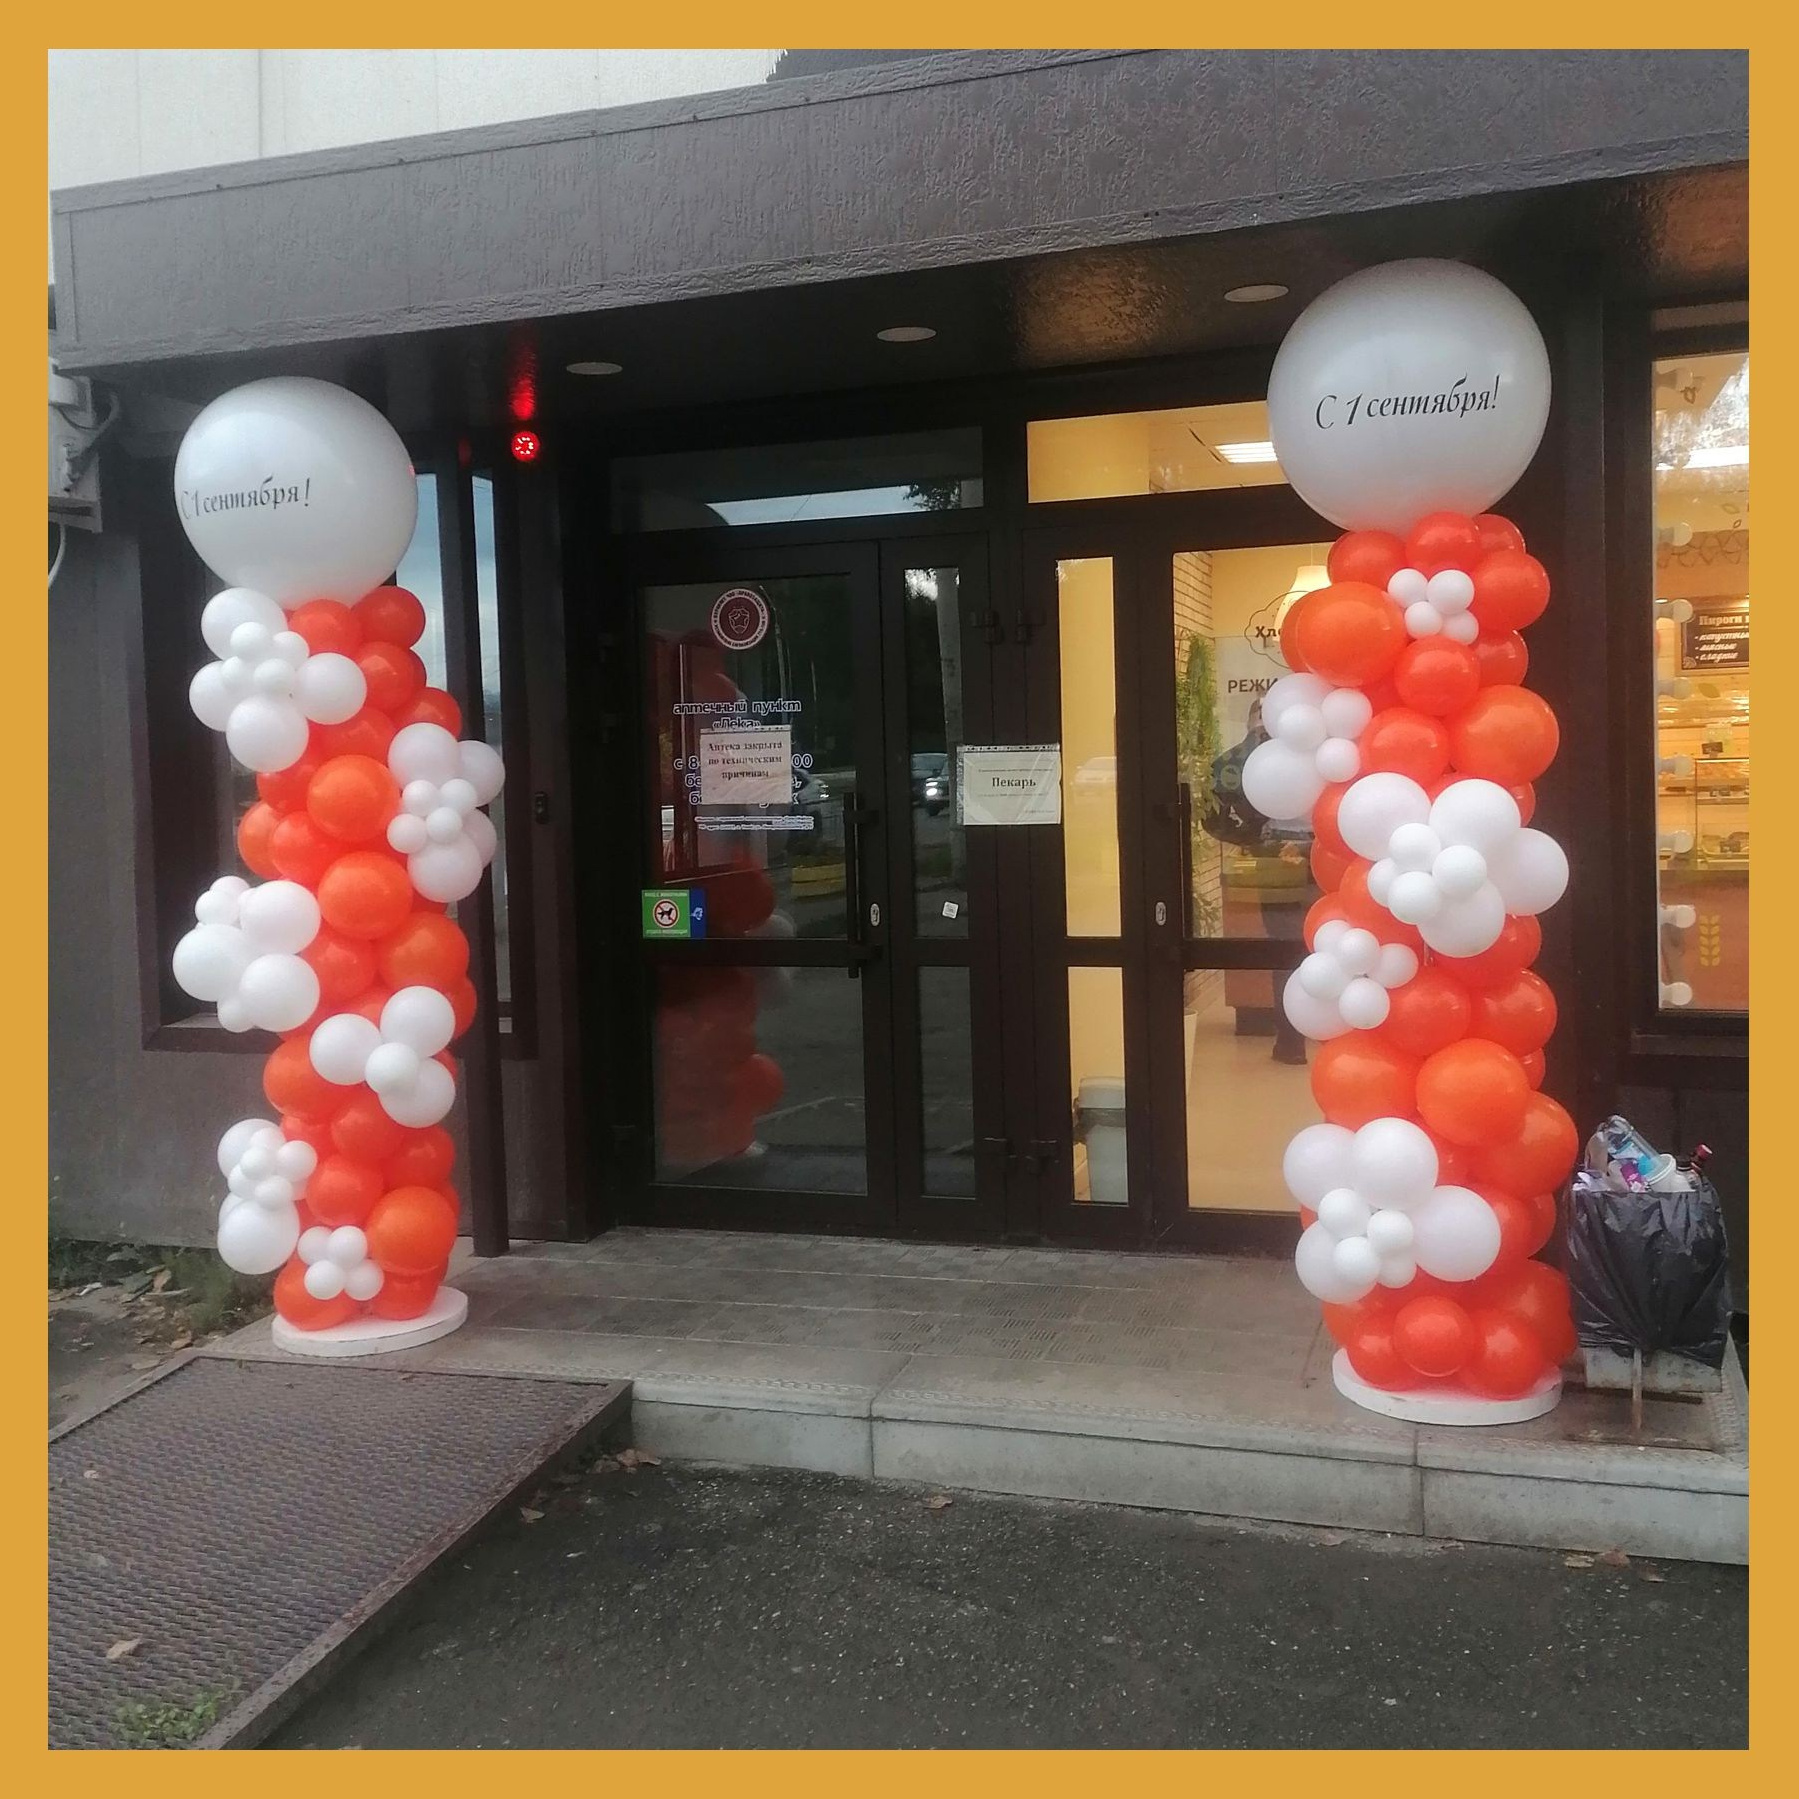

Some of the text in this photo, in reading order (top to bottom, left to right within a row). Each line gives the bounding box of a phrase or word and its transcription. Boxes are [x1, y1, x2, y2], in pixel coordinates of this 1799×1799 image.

[1316, 373, 1500, 429] С 1 сентября!
[203, 475, 310, 514] сентября!
[1699, 614, 1743, 627] Пироги
[1255, 625, 1281, 638] Хл
[673, 698, 802, 716] аптечный пункт
[708, 741, 783, 751] Аптека закрыта
[722, 756, 782, 764] техническим
[992, 777, 1037, 789] Пекарь
